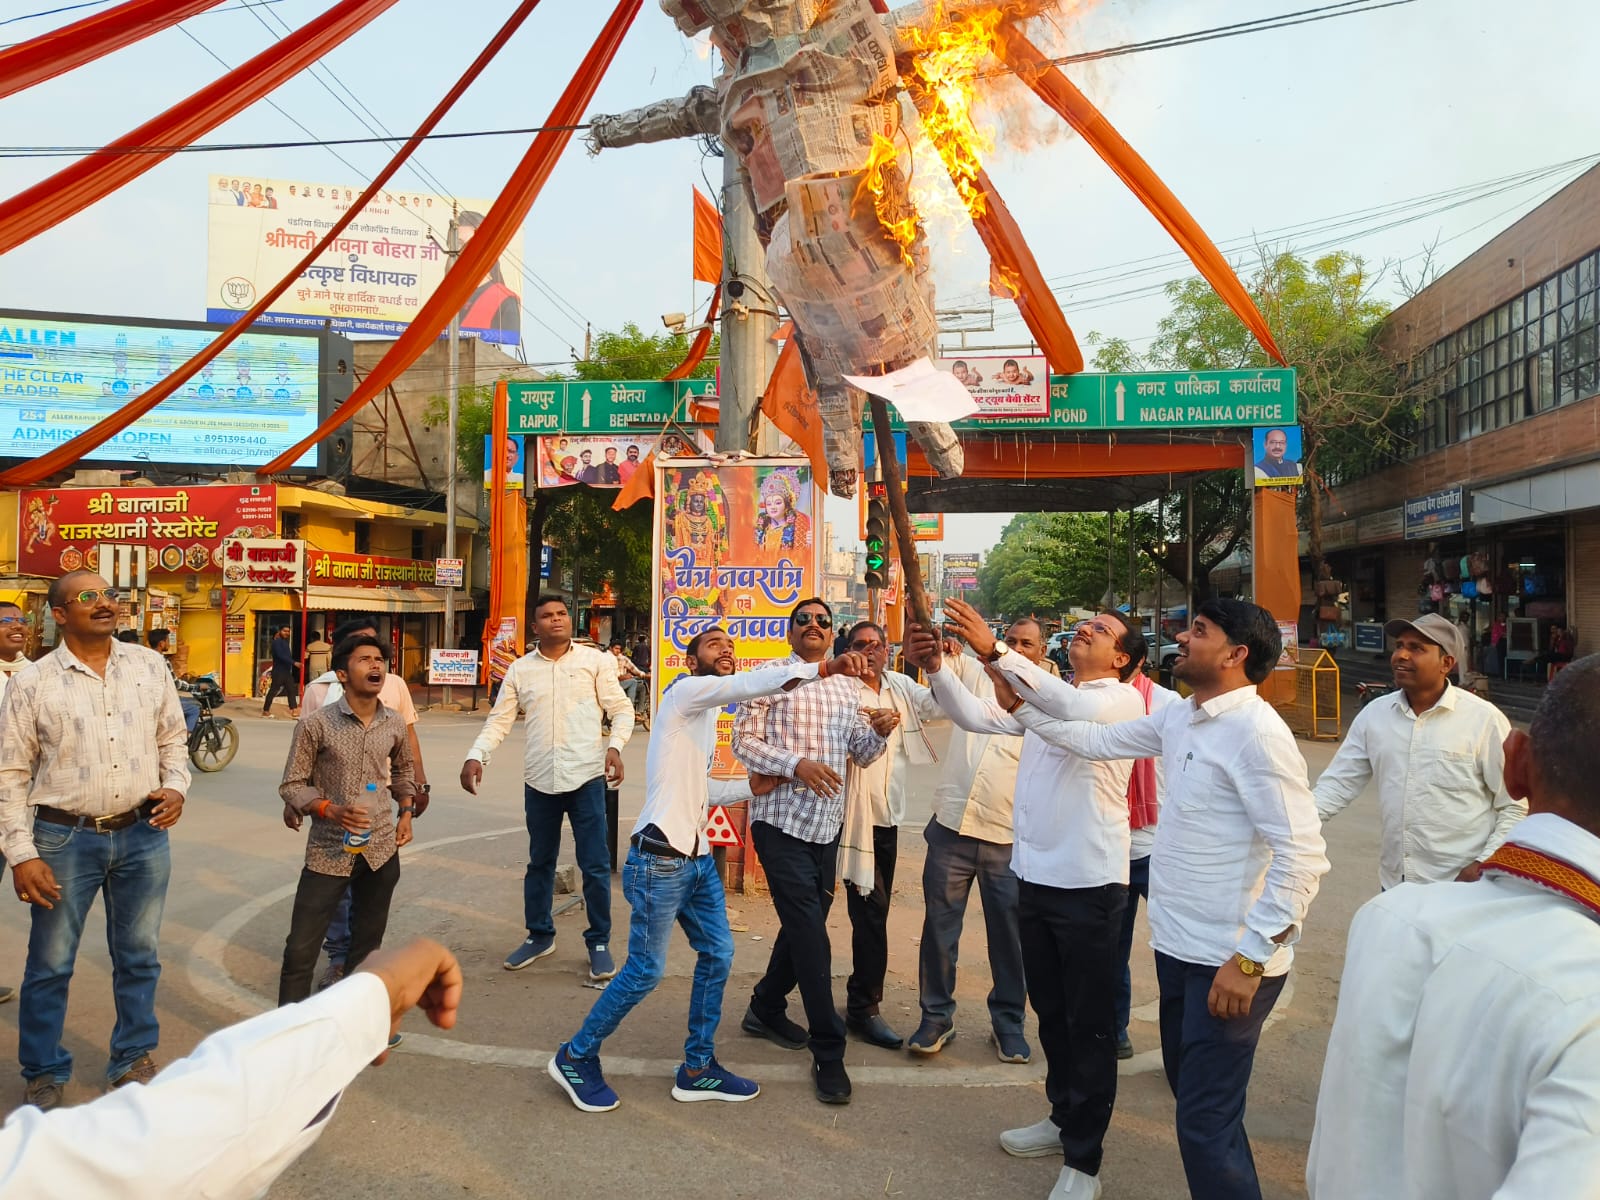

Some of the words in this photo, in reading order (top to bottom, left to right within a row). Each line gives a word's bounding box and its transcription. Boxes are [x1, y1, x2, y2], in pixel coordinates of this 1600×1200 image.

[265, 227, 317, 250] श्रीमती
[372, 237, 416, 259] बोहरा
[420, 242, 441, 261] जी
[351, 264, 417, 287] विधायक
[297, 288, 310, 301] चुने
[314, 289, 331, 300] जाने
[334, 292, 345, 301] पर
[348, 291, 376, 303] हार्दिक
[378, 292, 402, 305] बधाई
[405, 295, 418, 306] एवं
[0, 326, 77, 346] ALLEN
[30, 369, 84, 384] CLEAR
[1137, 381, 1167, 396] नगर
[1175, 376, 1220, 396] पालिका
[1229, 373, 1282, 393] कार्यालय
[3, 384, 59, 396] EADER
[610, 384, 646, 403] बेमेतरा
[520, 390, 556, 410] रायपुर
[985, 396, 1004, 405] ट्यूब
[1054, 409, 1087, 423] POND
[1140, 407, 1184, 422] NAGAR
[1188, 406, 1232, 421] PALIKA
[122, 431, 172, 445] OPEN
[204, 434, 267, 445] 8951395440
[87, 492, 114, 514] श्री
[117, 490, 189, 513] बालाजी
[58, 517, 149, 540] राजस्थानी
[151, 515, 219, 539] रेस्टोरेंट
[227, 541, 244, 562] श्री
[247, 542, 298, 563] बालाजी
[315, 553, 331, 578] श्री
[332, 561, 359, 579] बाला
[360, 558, 373, 580] जी
[375, 562, 417, 581] राजस्थानी
[665, 546, 712, 588] चैत्र
[717, 558, 804, 604] नवरात्रि
[735, 597, 752, 614] एवं
[665, 655, 680, 668] की
